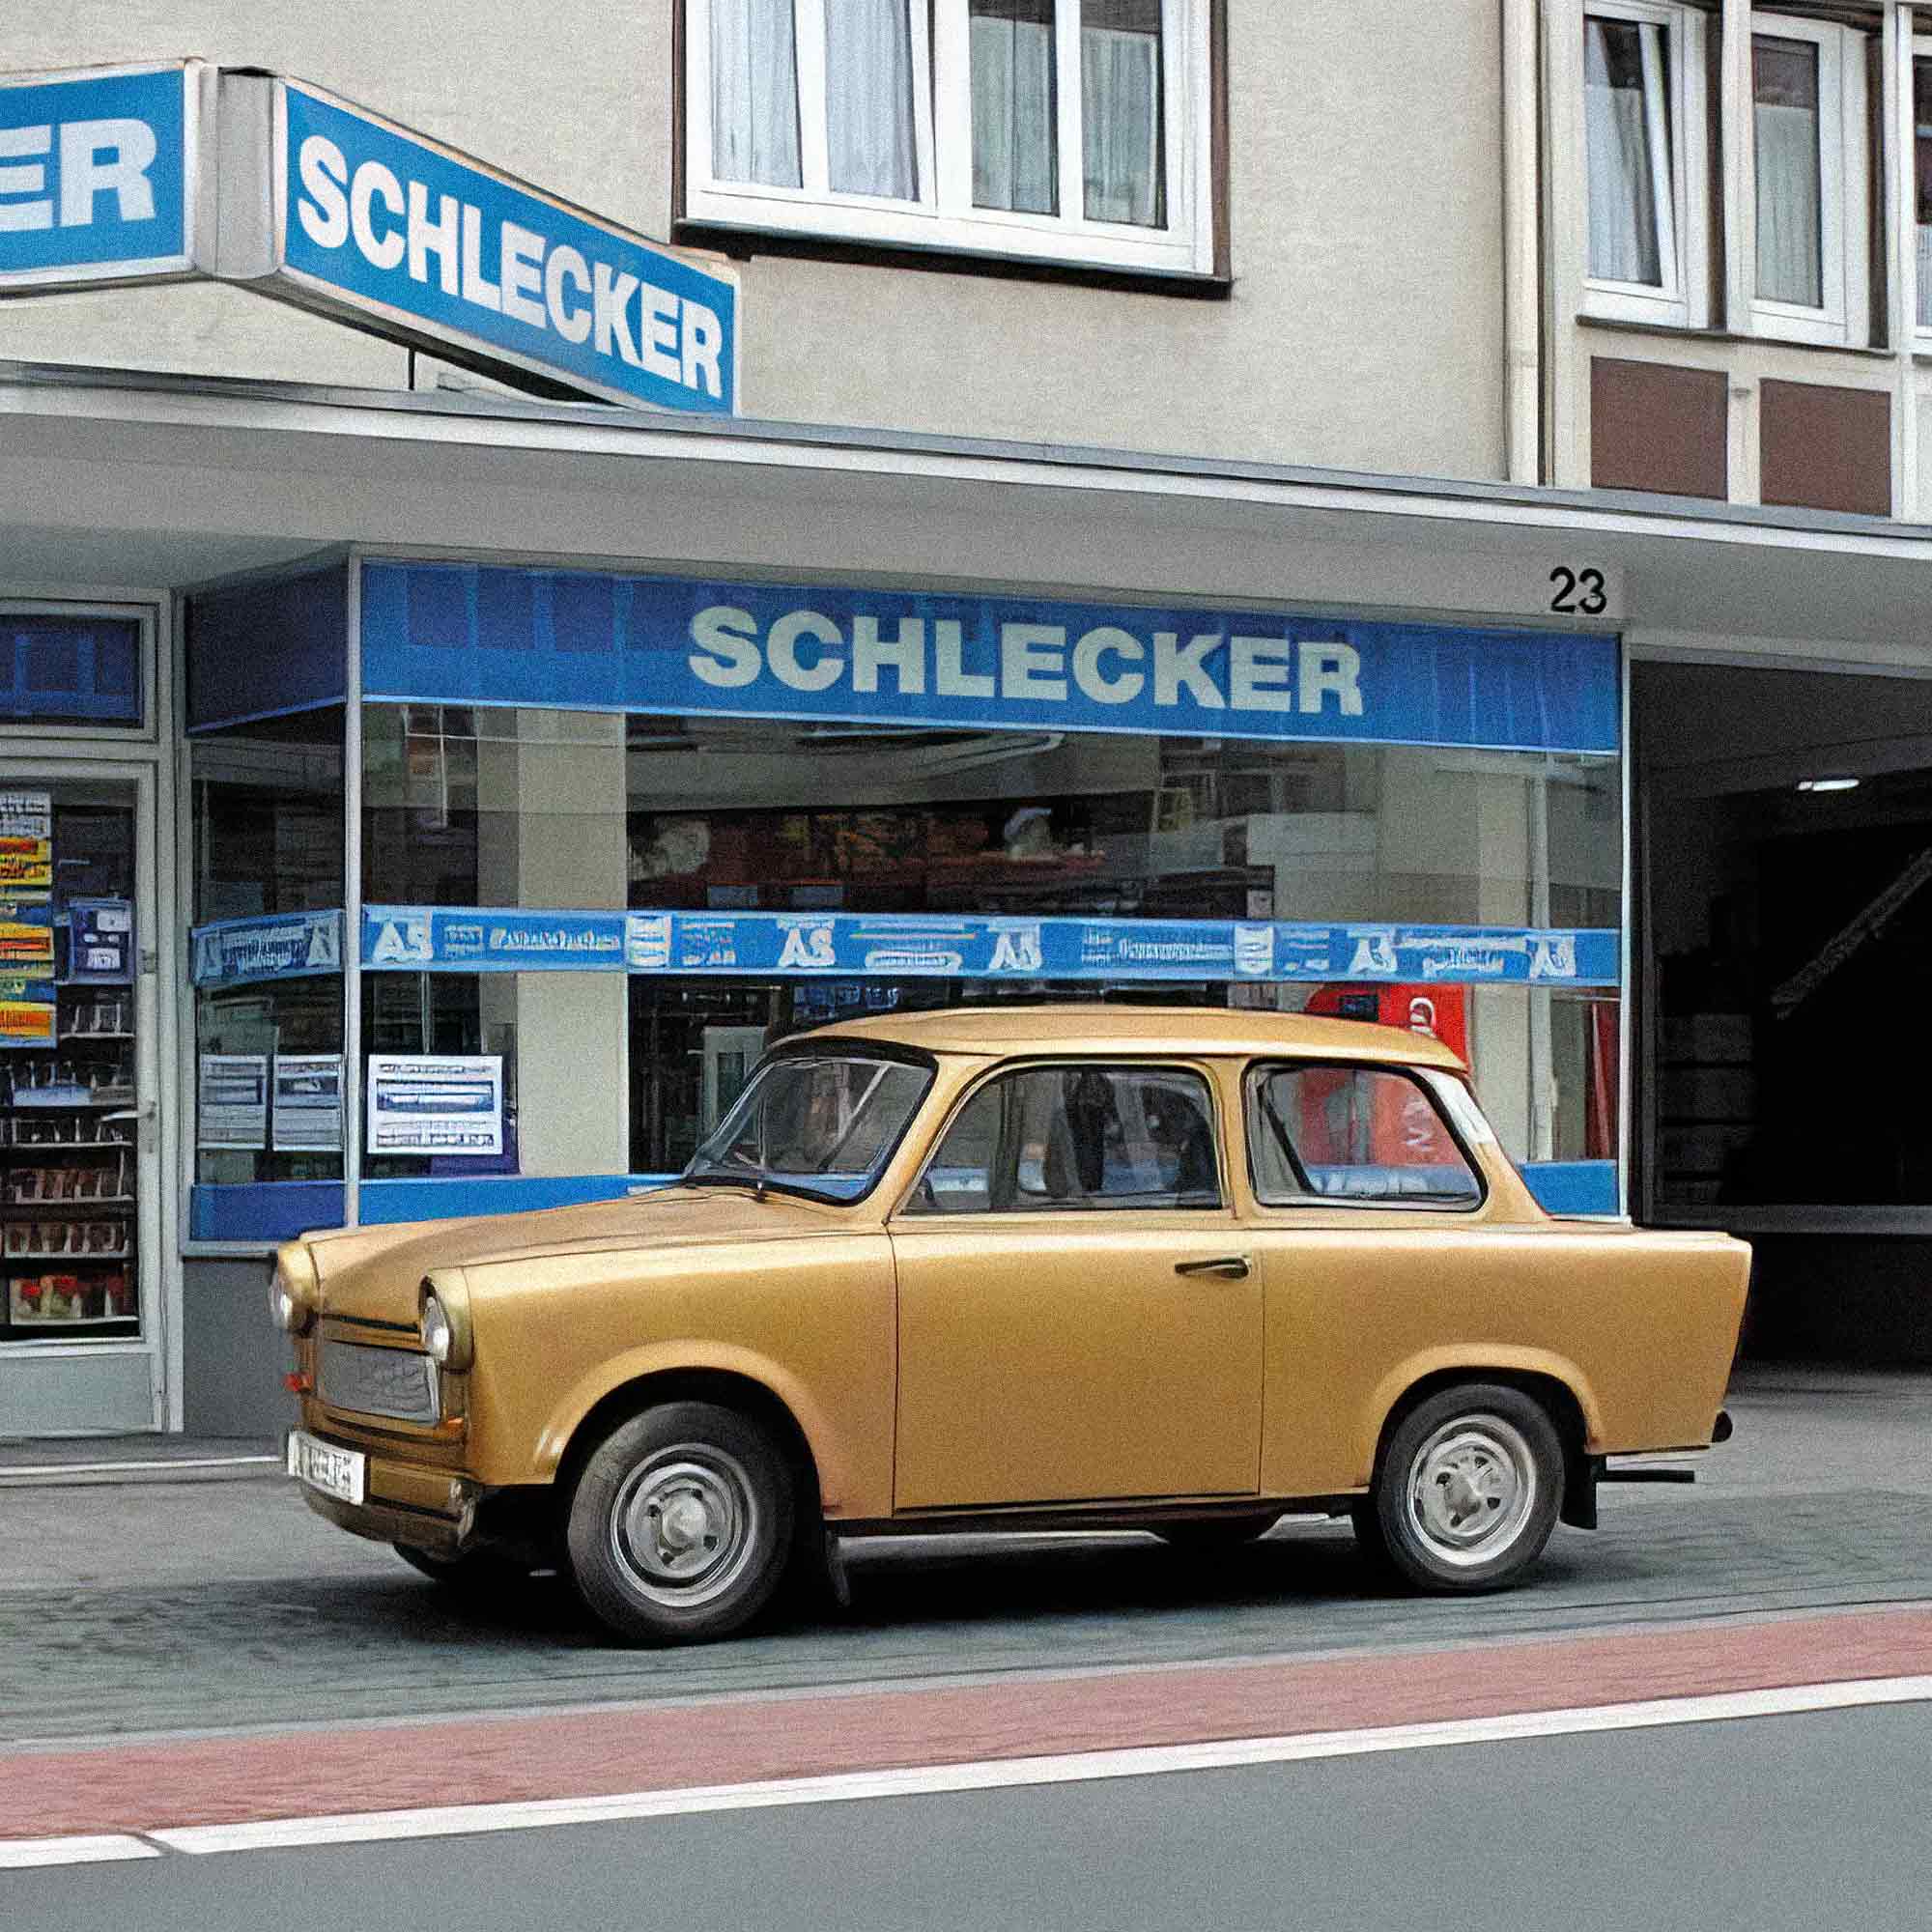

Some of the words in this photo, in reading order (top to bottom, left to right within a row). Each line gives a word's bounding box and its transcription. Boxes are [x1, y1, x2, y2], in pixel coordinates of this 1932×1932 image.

[298, 134, 724, 398] SCHLECKER
[1549, 566, 1607, 614] 23
[688, 606, 1365, 716] SCHLECKER
